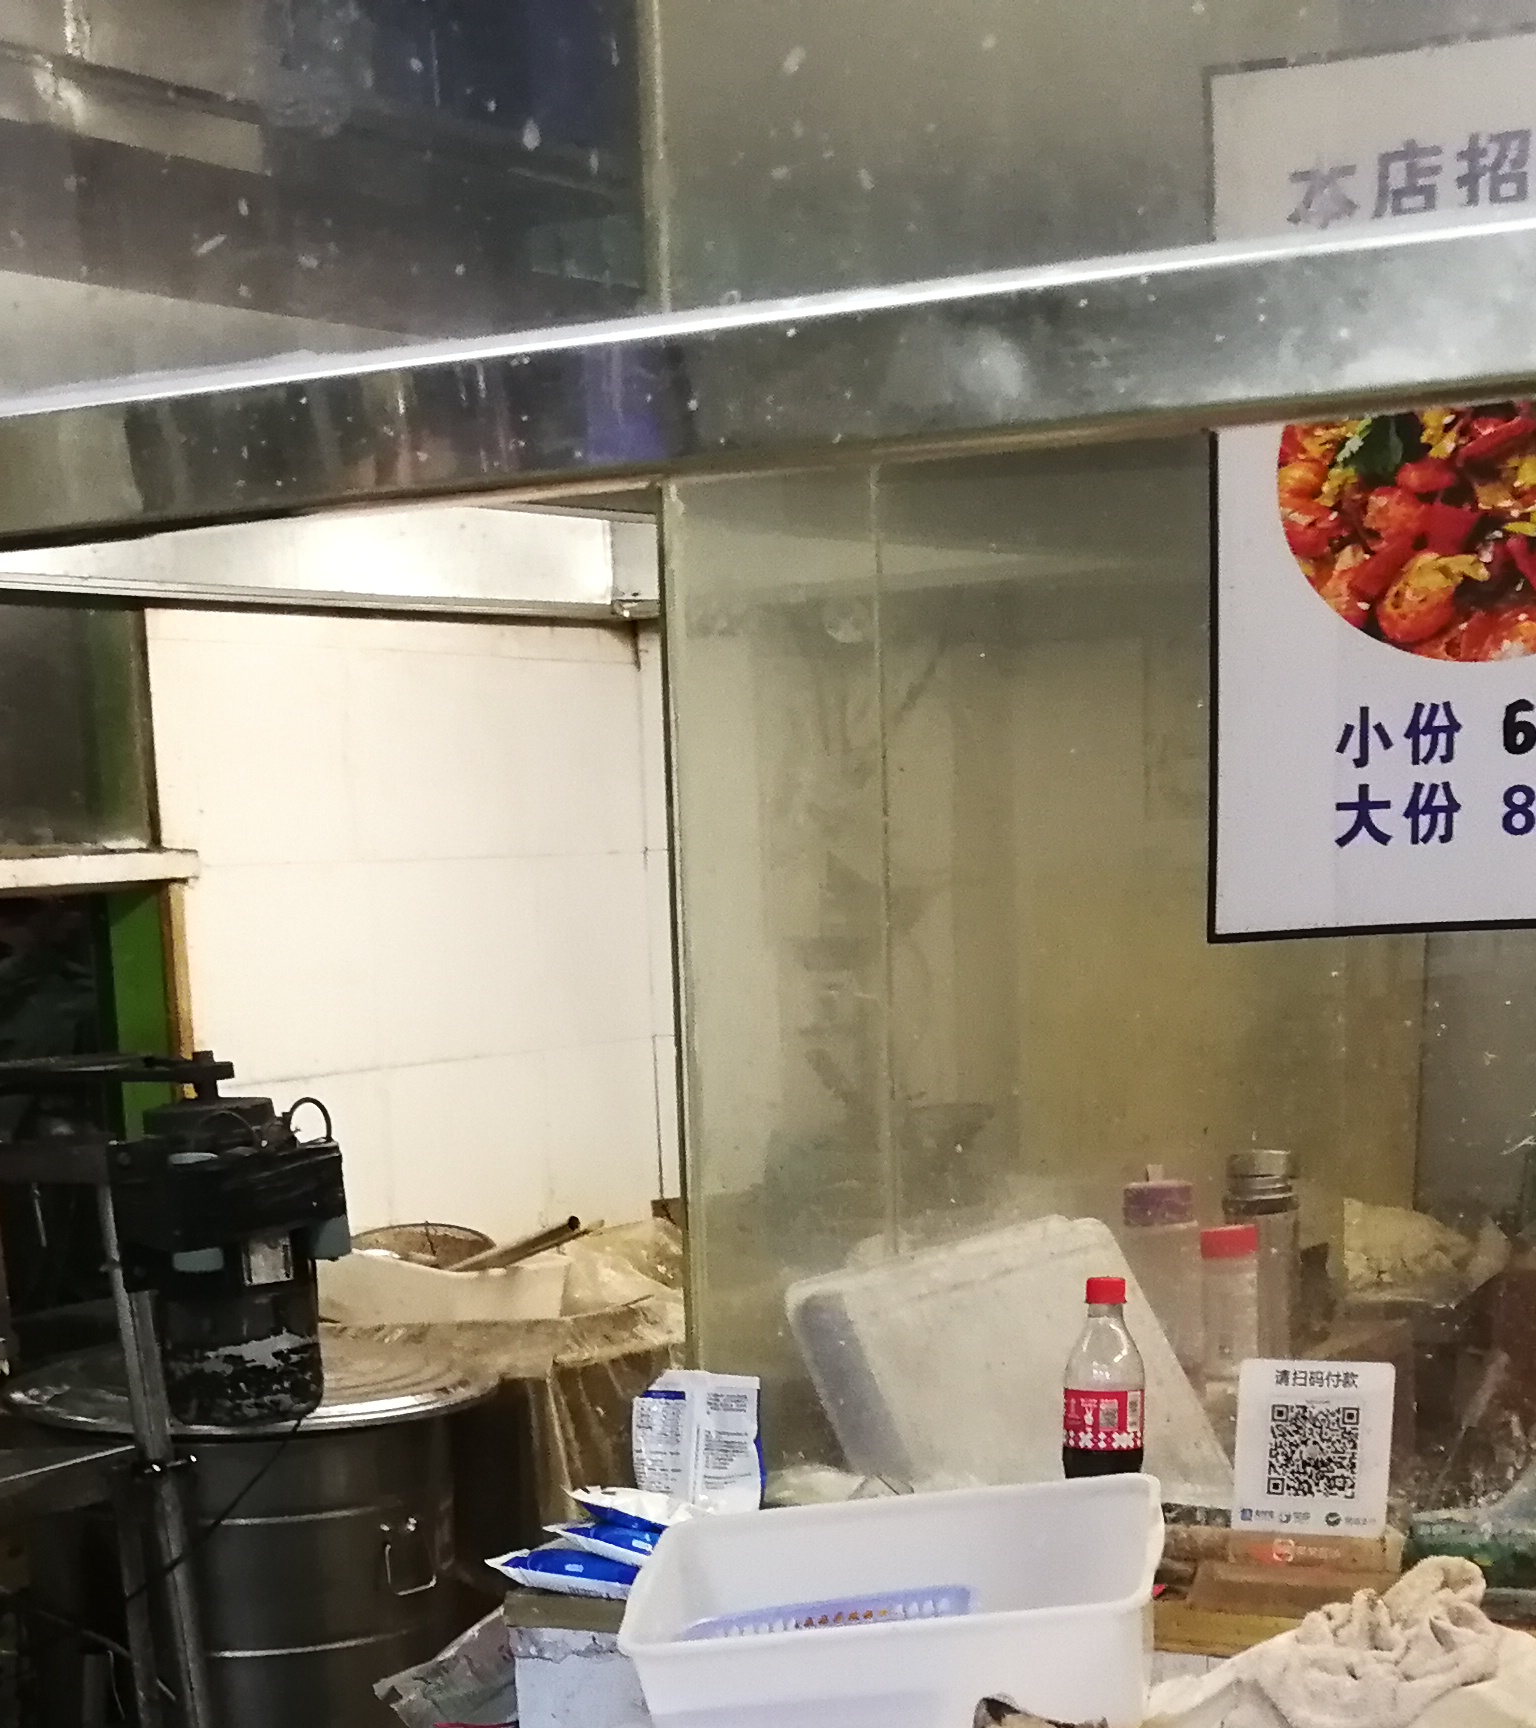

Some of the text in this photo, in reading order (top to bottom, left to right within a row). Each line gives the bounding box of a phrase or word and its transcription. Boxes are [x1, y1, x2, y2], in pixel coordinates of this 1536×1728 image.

[1334, 699, 1464, 770] 小份
[1333, 779, 1463, 850] 大份
[1275, 1368, 1359, 1389] 请扫码付款
